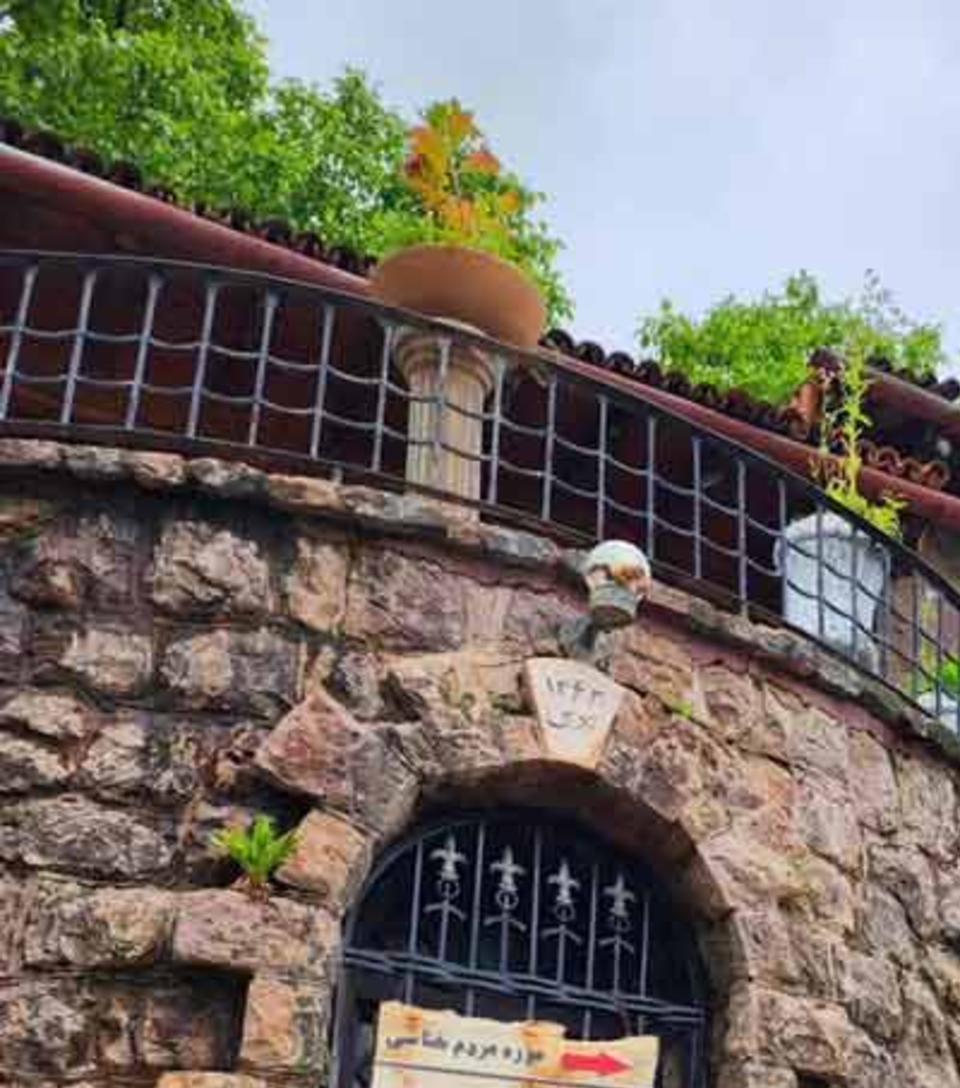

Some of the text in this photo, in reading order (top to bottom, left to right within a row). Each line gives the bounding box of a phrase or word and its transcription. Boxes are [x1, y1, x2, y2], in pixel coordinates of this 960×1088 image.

[385, 1029, 544, 1065] موزه مردم شناسی
